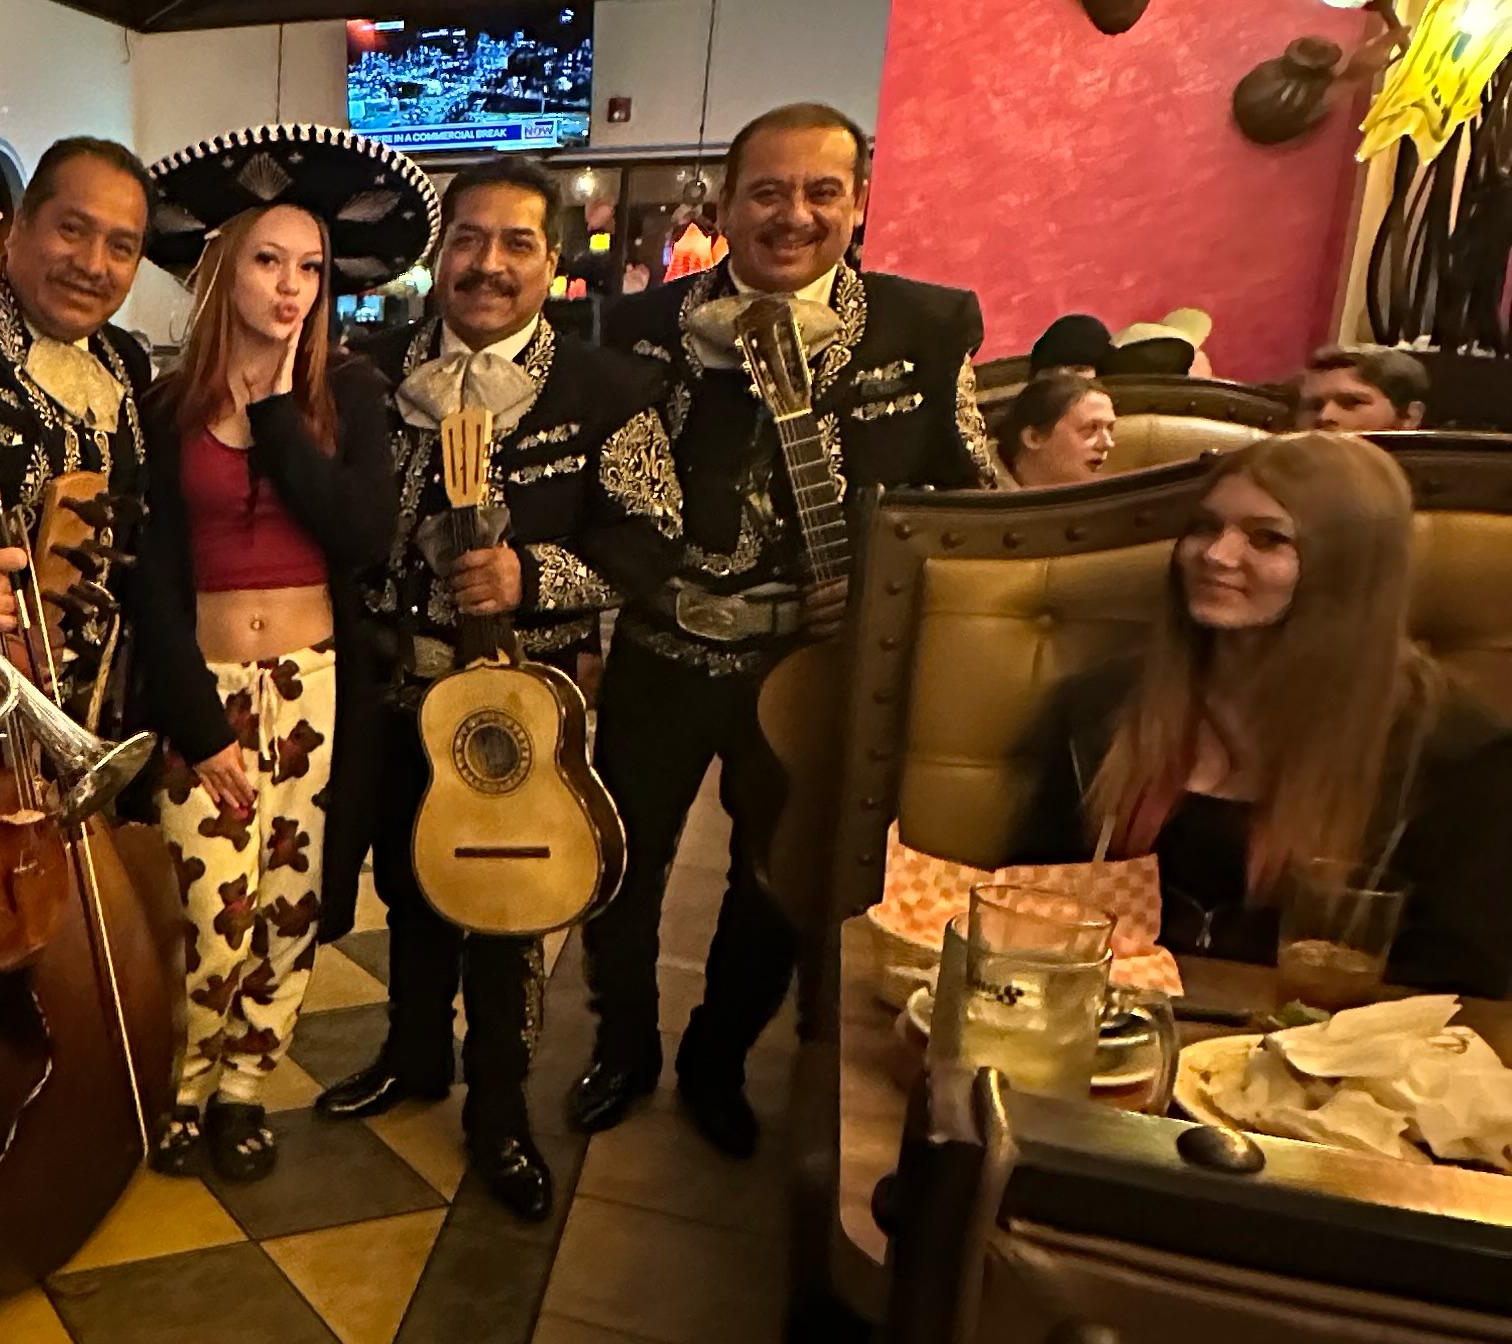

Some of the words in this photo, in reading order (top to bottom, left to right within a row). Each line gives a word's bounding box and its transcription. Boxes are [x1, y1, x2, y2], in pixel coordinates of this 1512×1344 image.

[394, 133, 404, 143] IN
[412, 129, 475, 143] COMMERCIAL
[476, 128, 507, 138] BREAK
